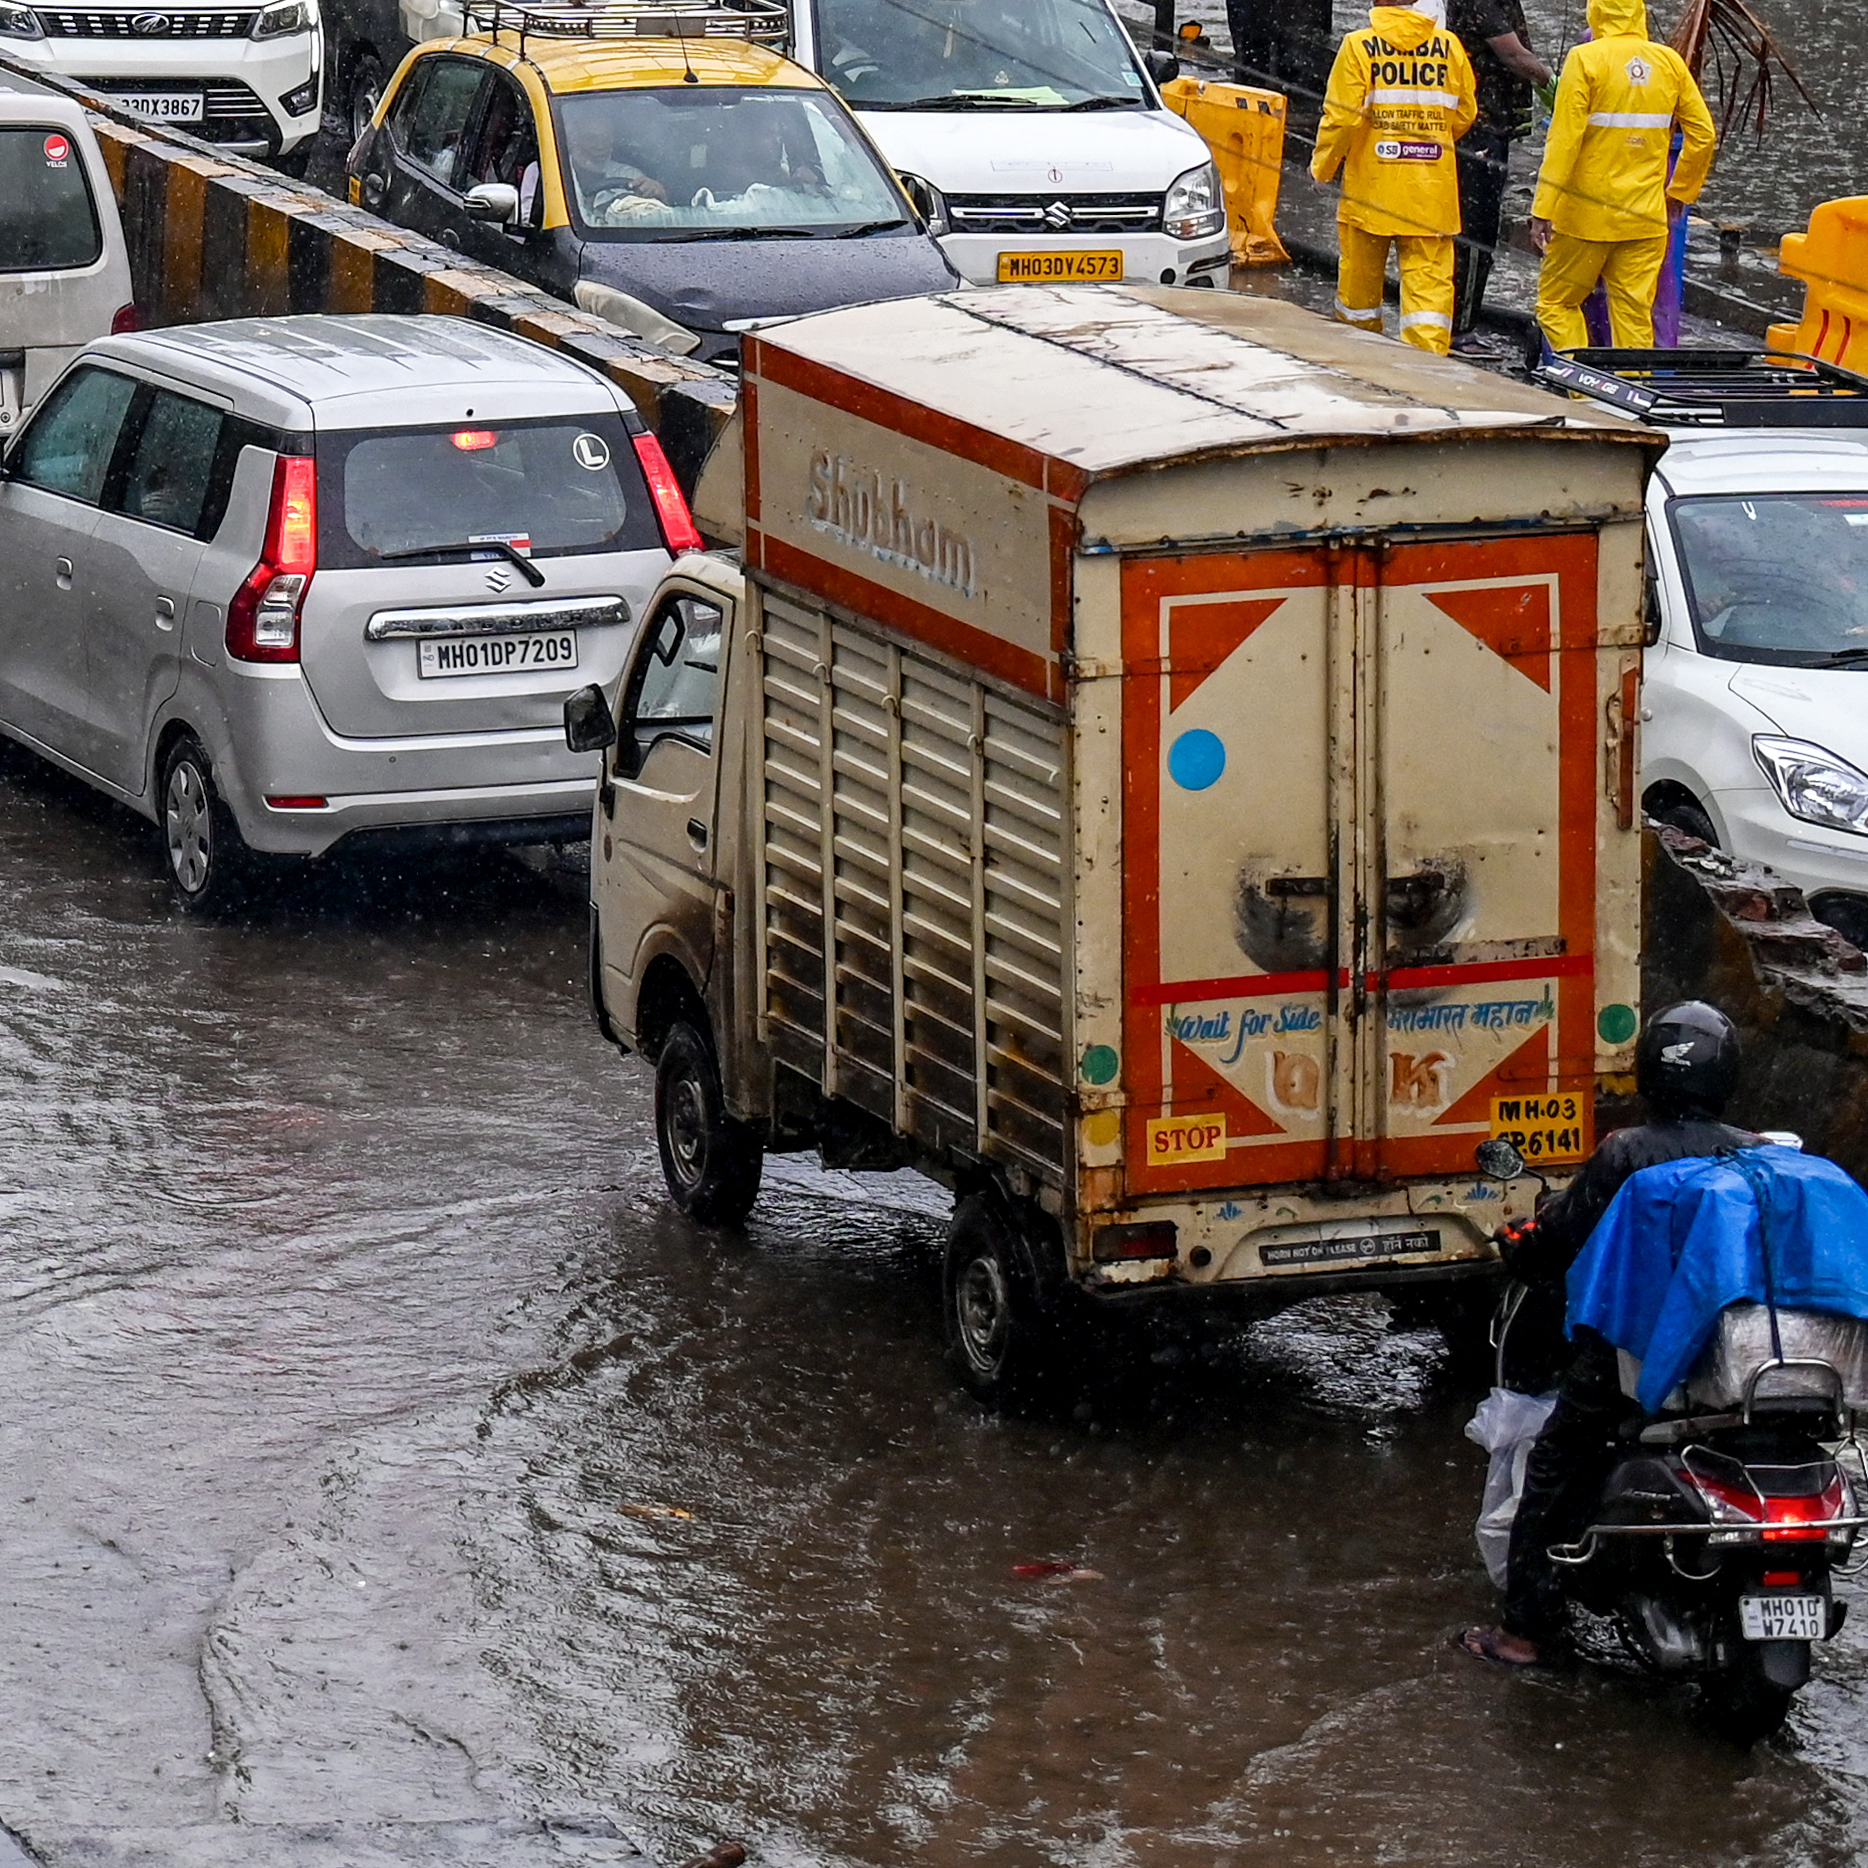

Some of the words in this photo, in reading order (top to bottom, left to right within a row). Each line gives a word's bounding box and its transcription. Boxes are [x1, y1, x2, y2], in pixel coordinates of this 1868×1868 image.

[1361, 35, 1450, 60] MUBAI
[1370, 61, 1448, 87] POLICE
[1396, 108, 1425, 119] TRAFFIC
[1402, 143, 1438, 157] general
[1009, 258, 1119, 278] MH03DV4573
[578, 439, 605, 465] L
[807, 449, 974, 598] Shubham
[437, 635, 574, 671] MH01DP7209
[1175, 1009, 1230, 1042] Wait
[1218, 1007, 1272, 1065] for
[1272, 1003, 1322, 1036] Side
[1389, 1050, 1448, 1109] K
[1154, 1124, 1221, 1154] STOP
[1761, 1599, 1818, 1618] MH01D
[1763, 1619, 1821, 1638] W7410
